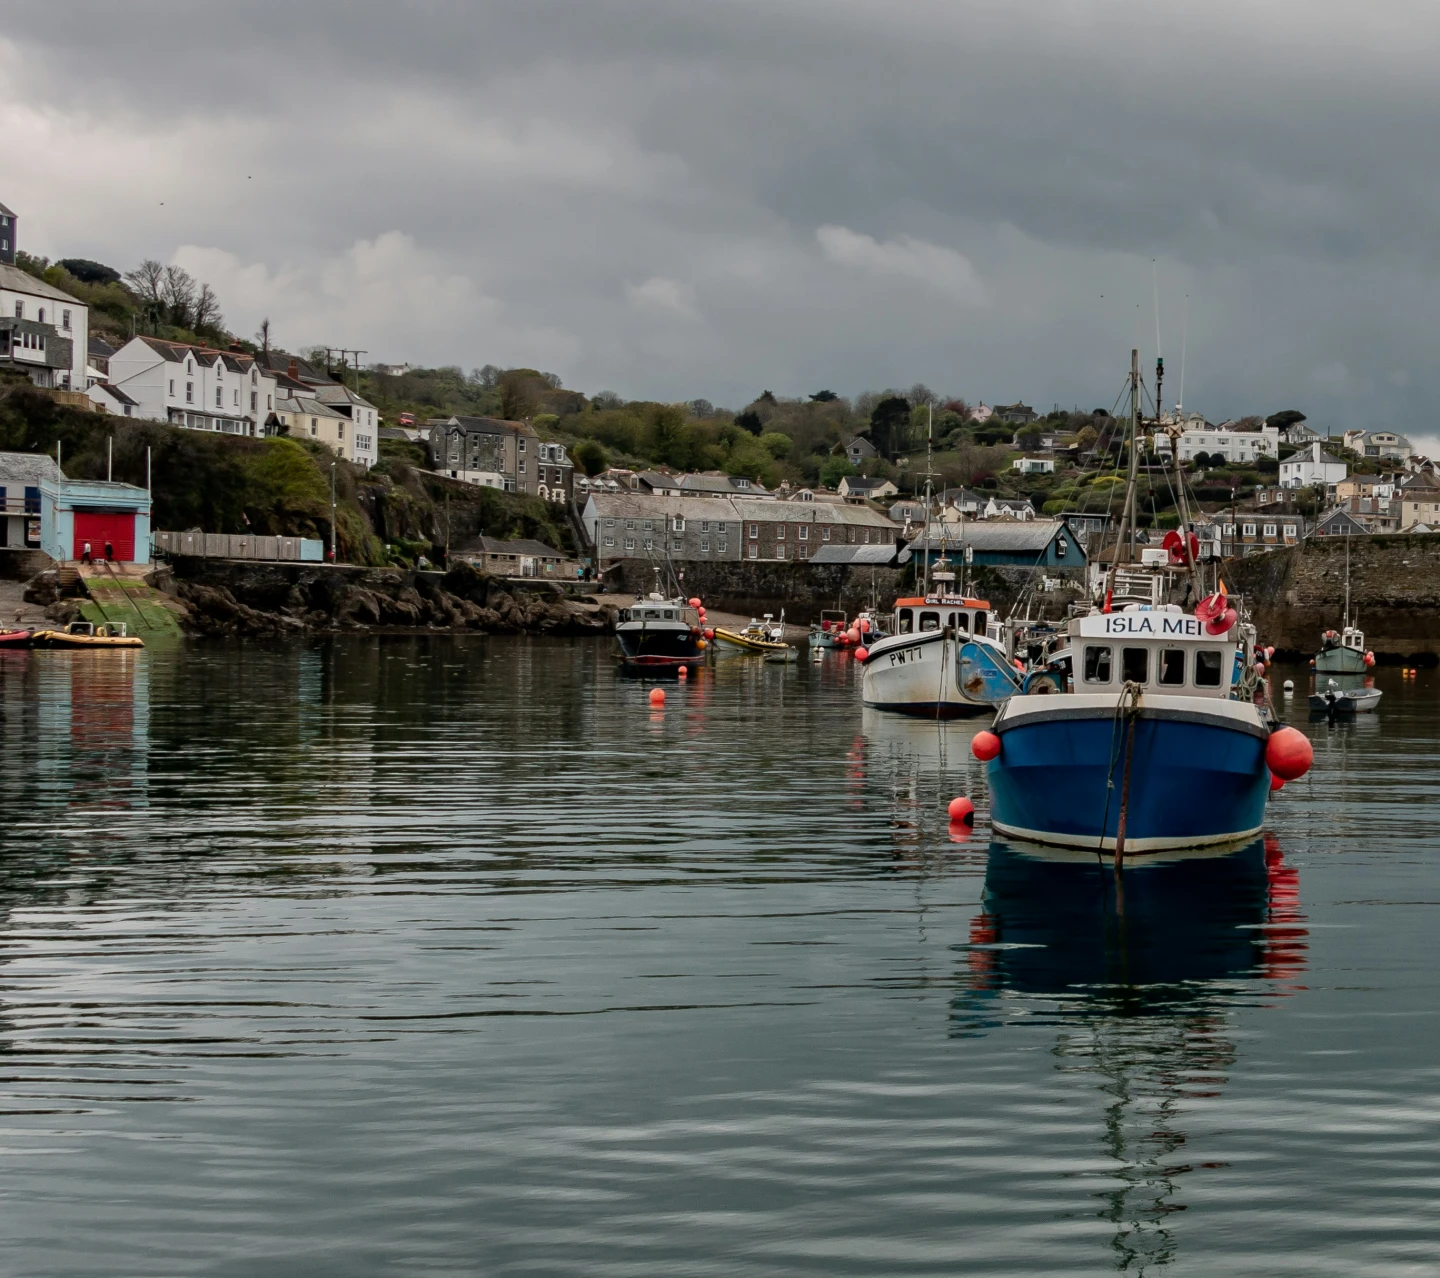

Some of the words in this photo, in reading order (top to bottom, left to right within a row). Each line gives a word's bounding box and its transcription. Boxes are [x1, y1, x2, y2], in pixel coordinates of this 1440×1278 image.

[1106, 618, 1153, 633] ISLA
[1163, 618, 1202, 636] MEI
[890, 647, 921, 666] PW77
